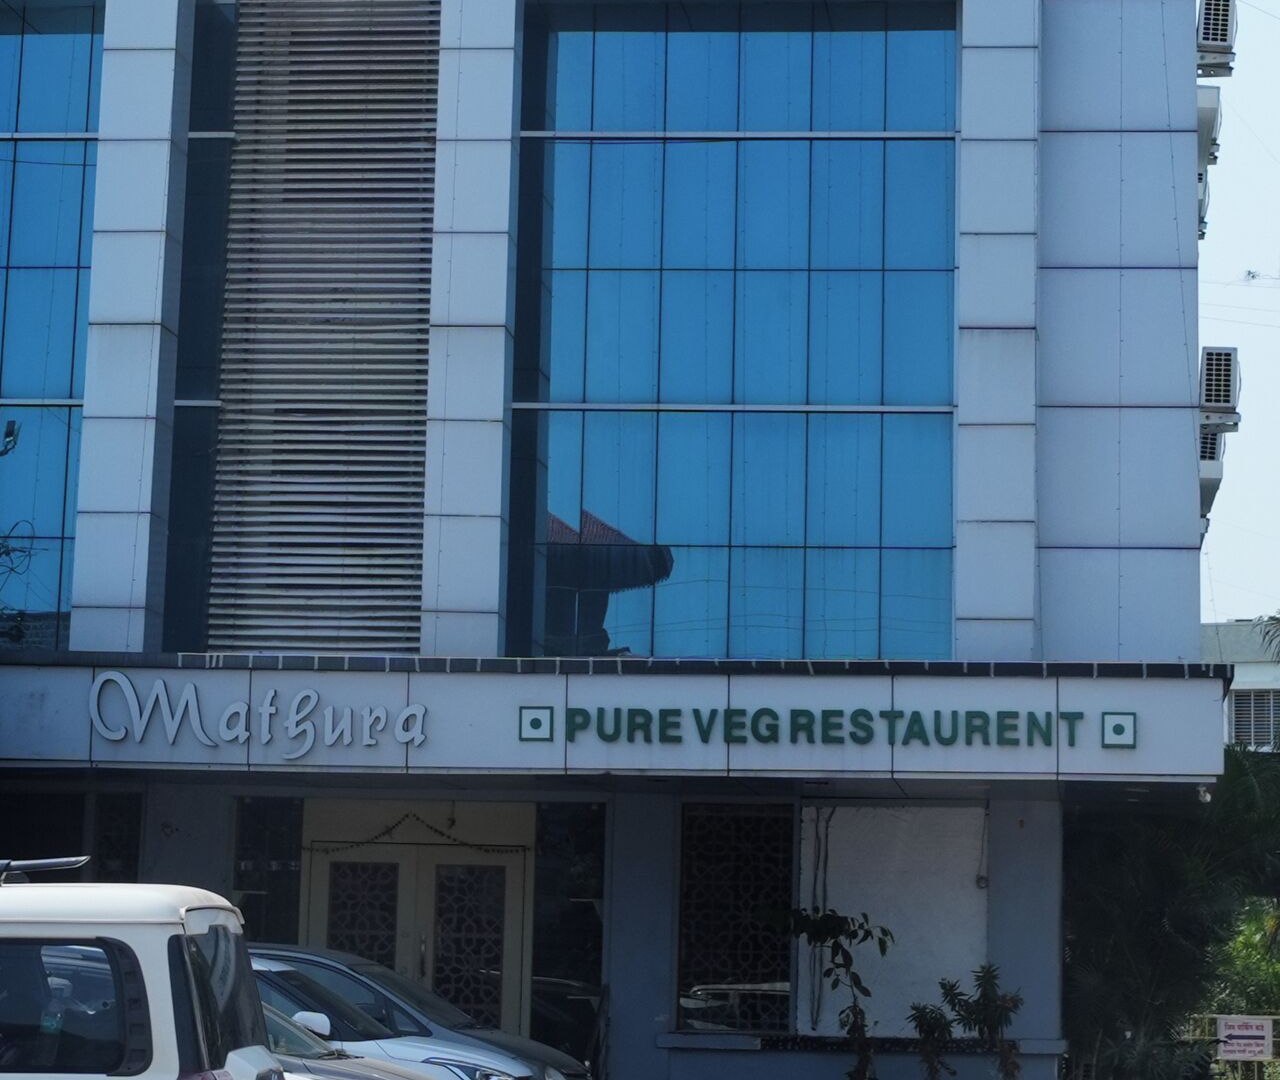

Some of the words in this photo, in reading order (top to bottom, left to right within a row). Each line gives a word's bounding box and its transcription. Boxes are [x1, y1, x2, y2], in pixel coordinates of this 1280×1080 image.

[567, 708, 683, 744] PURE
[692, 709, 780, 745] VEG
[789, 709, 1085, 747] RESTAURENT
